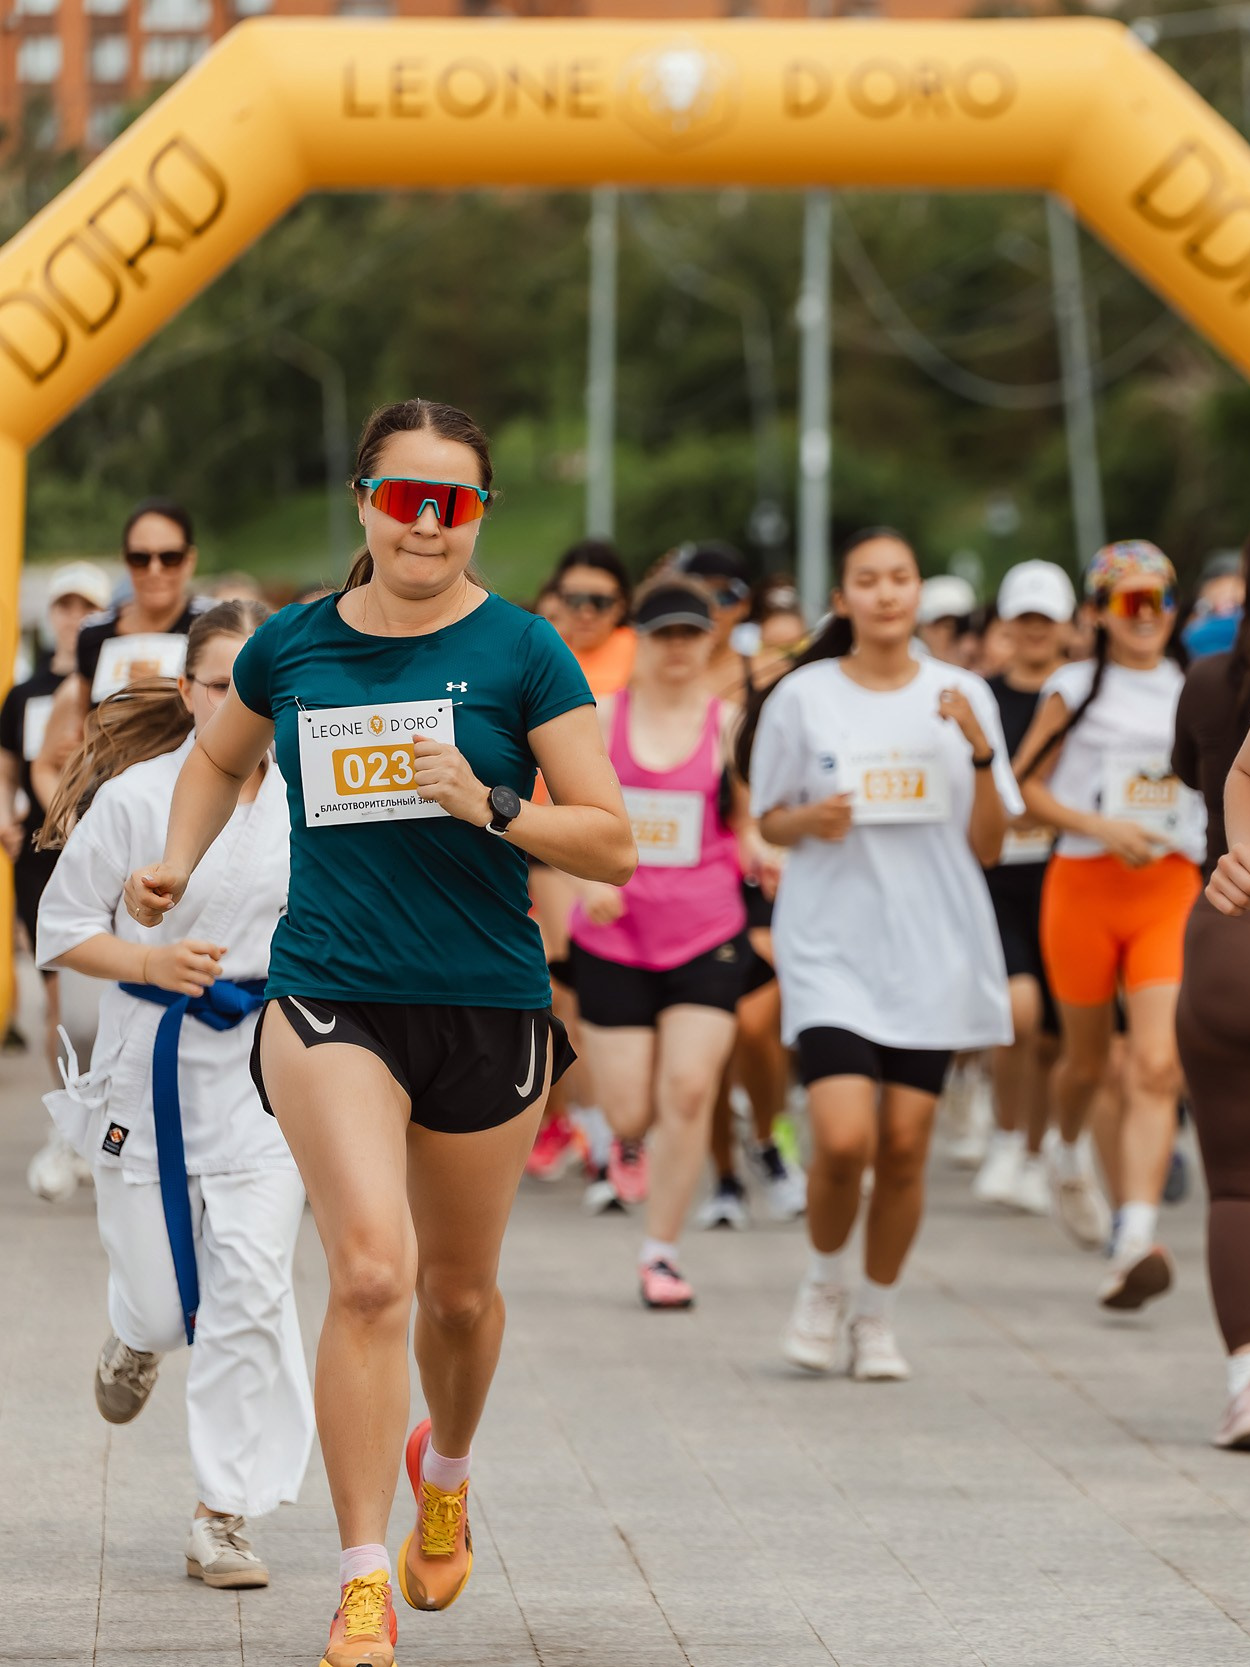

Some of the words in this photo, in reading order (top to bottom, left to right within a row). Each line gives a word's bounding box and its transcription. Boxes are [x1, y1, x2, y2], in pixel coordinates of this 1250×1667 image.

[340, 55, 602, 120] LEONE
[311, 721, 363, 738] LEONE
[390, 716, 438, 732] D'ORO
[342, 750, 413, 789] 023
[320, 796, 416, 812] БЛАГОТВОРИТЕЛЬНЫЙ
